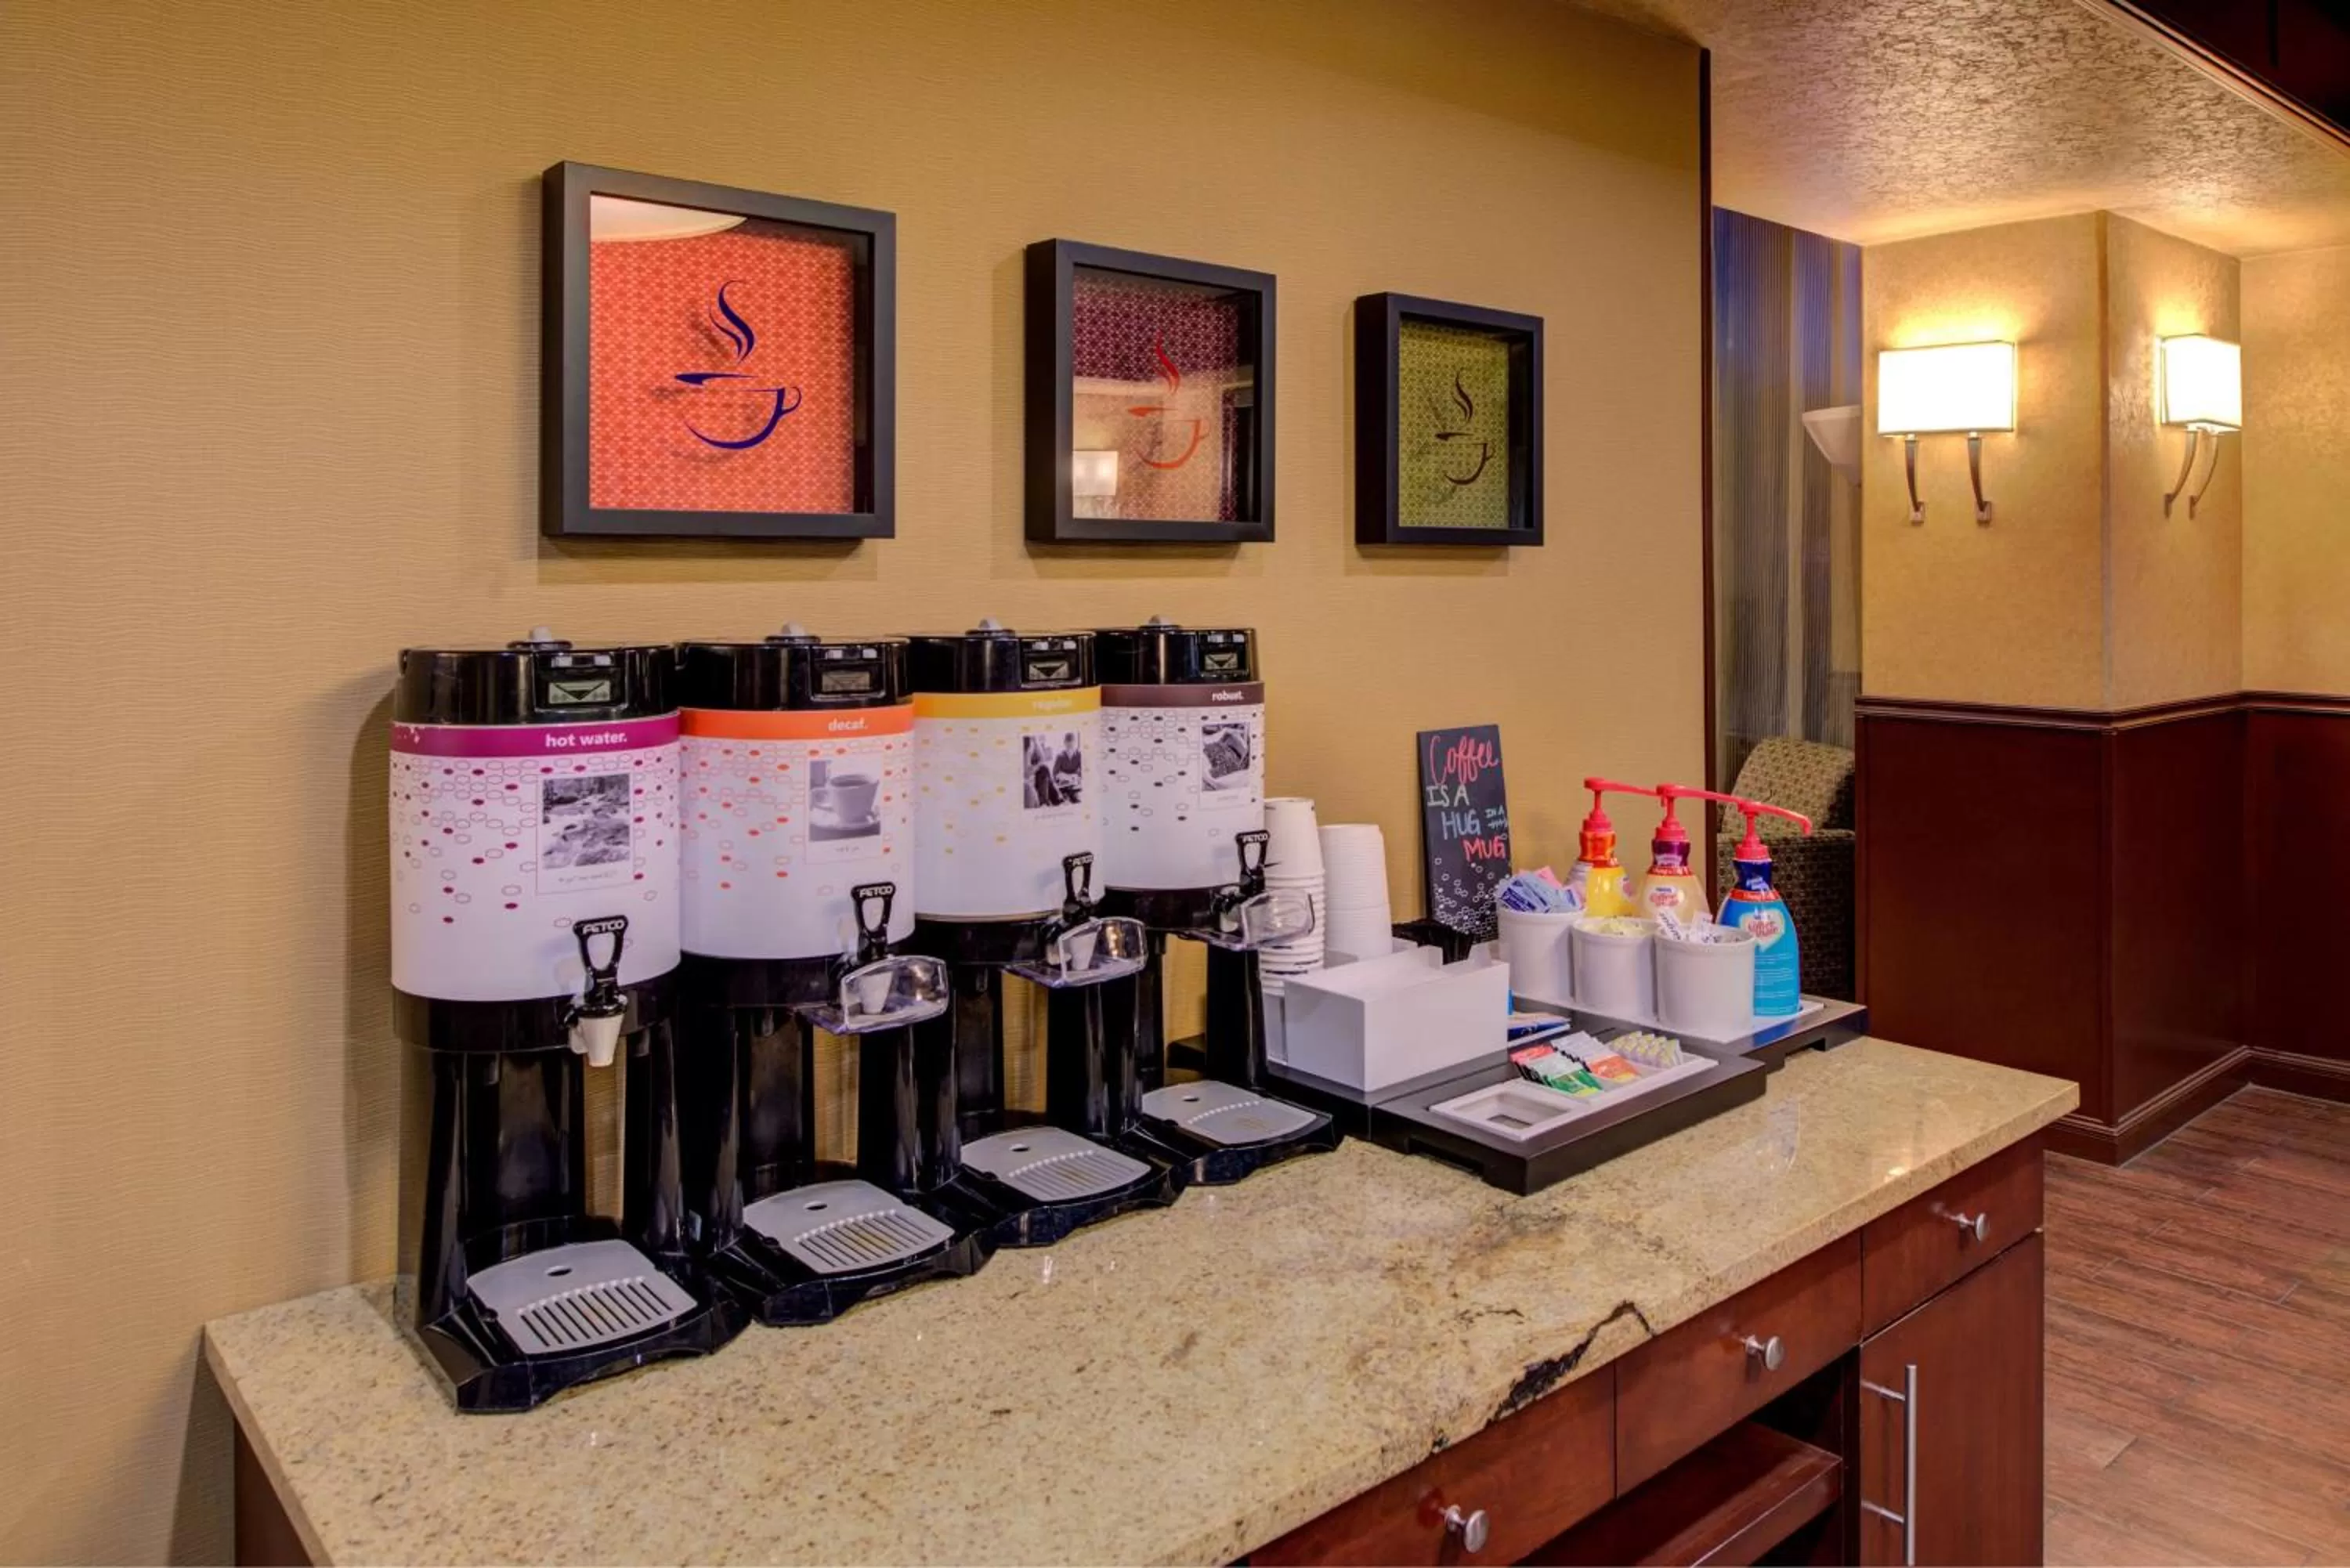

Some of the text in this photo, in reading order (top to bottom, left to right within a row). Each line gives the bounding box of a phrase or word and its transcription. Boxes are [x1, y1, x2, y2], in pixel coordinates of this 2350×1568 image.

[544, 732, 627, 748] hot water.
[1430, 735, 1499, 786] Coffee
[1426, 784, 1470, 807] IS A
[1441, 808, 1482, 840] HUG
[1462, 836, 1506, 862] MUG
[582, 919, 625, 934] FETCO
